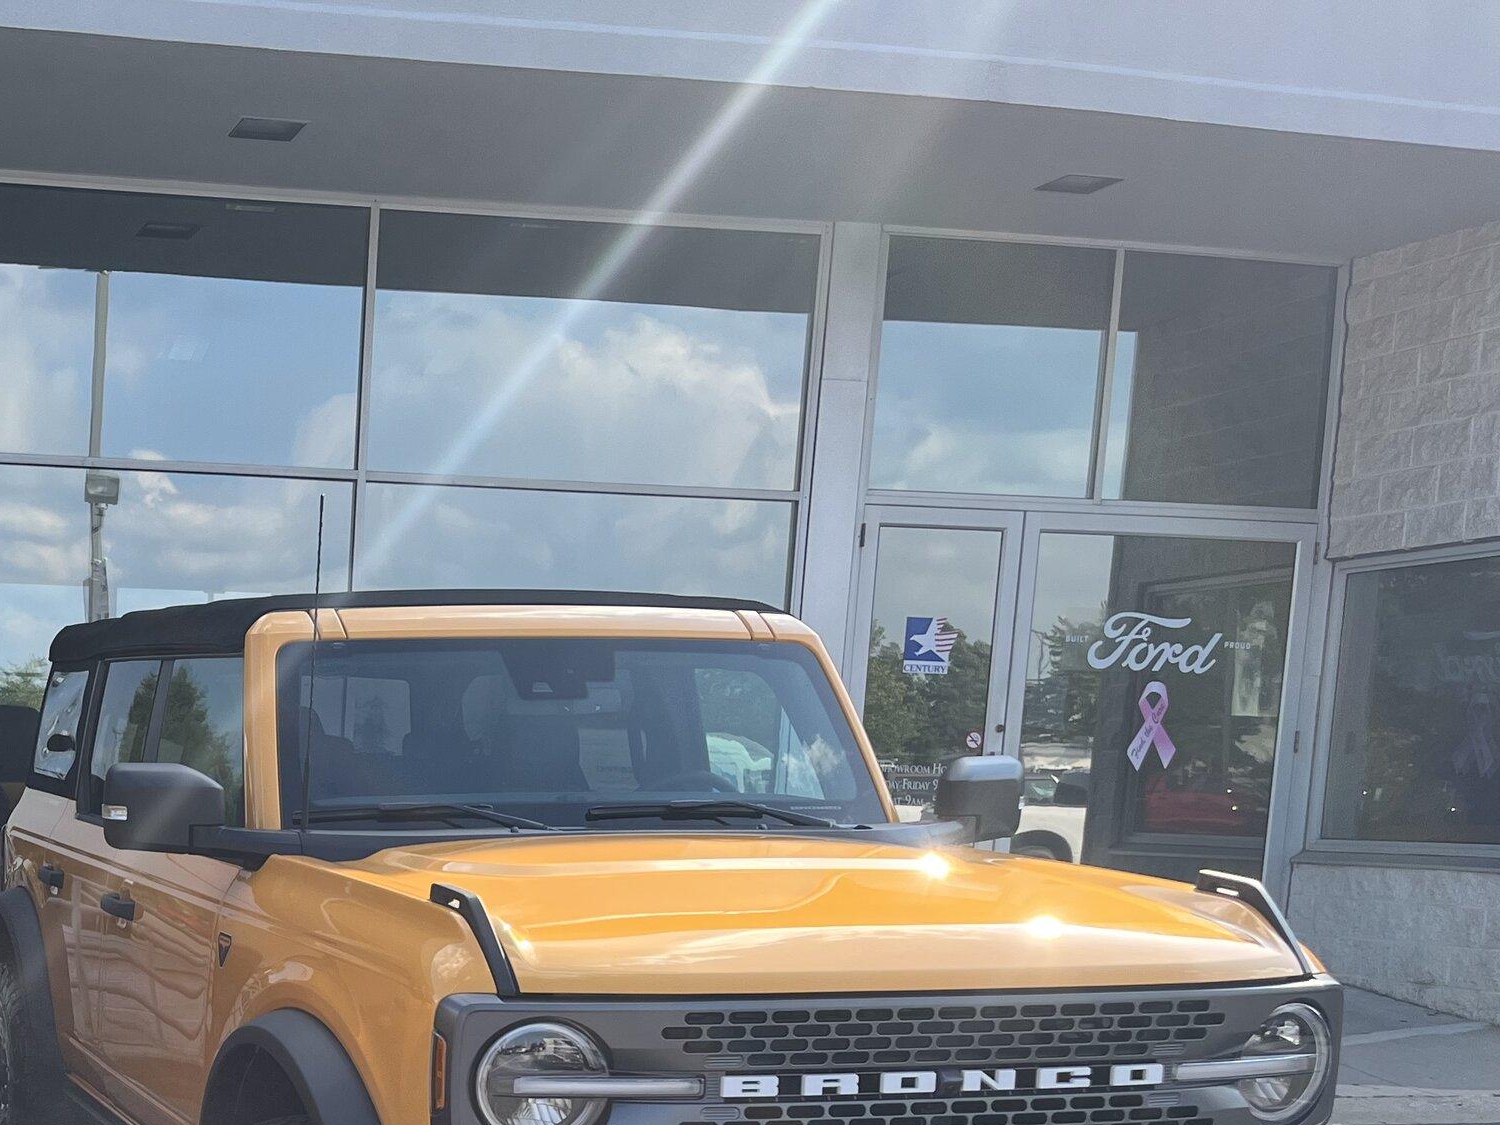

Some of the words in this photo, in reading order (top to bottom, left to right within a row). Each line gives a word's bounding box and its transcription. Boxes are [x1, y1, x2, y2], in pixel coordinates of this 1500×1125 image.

[1065, 635, 1089, 643] BUILT
[1087, 611, 1223, 674] Ford
[1223, 641, 1251, 650] PROUD
[903, 663, 947, 674] CENTURY
[719, 1062, 1165, 1098] BRONCO
